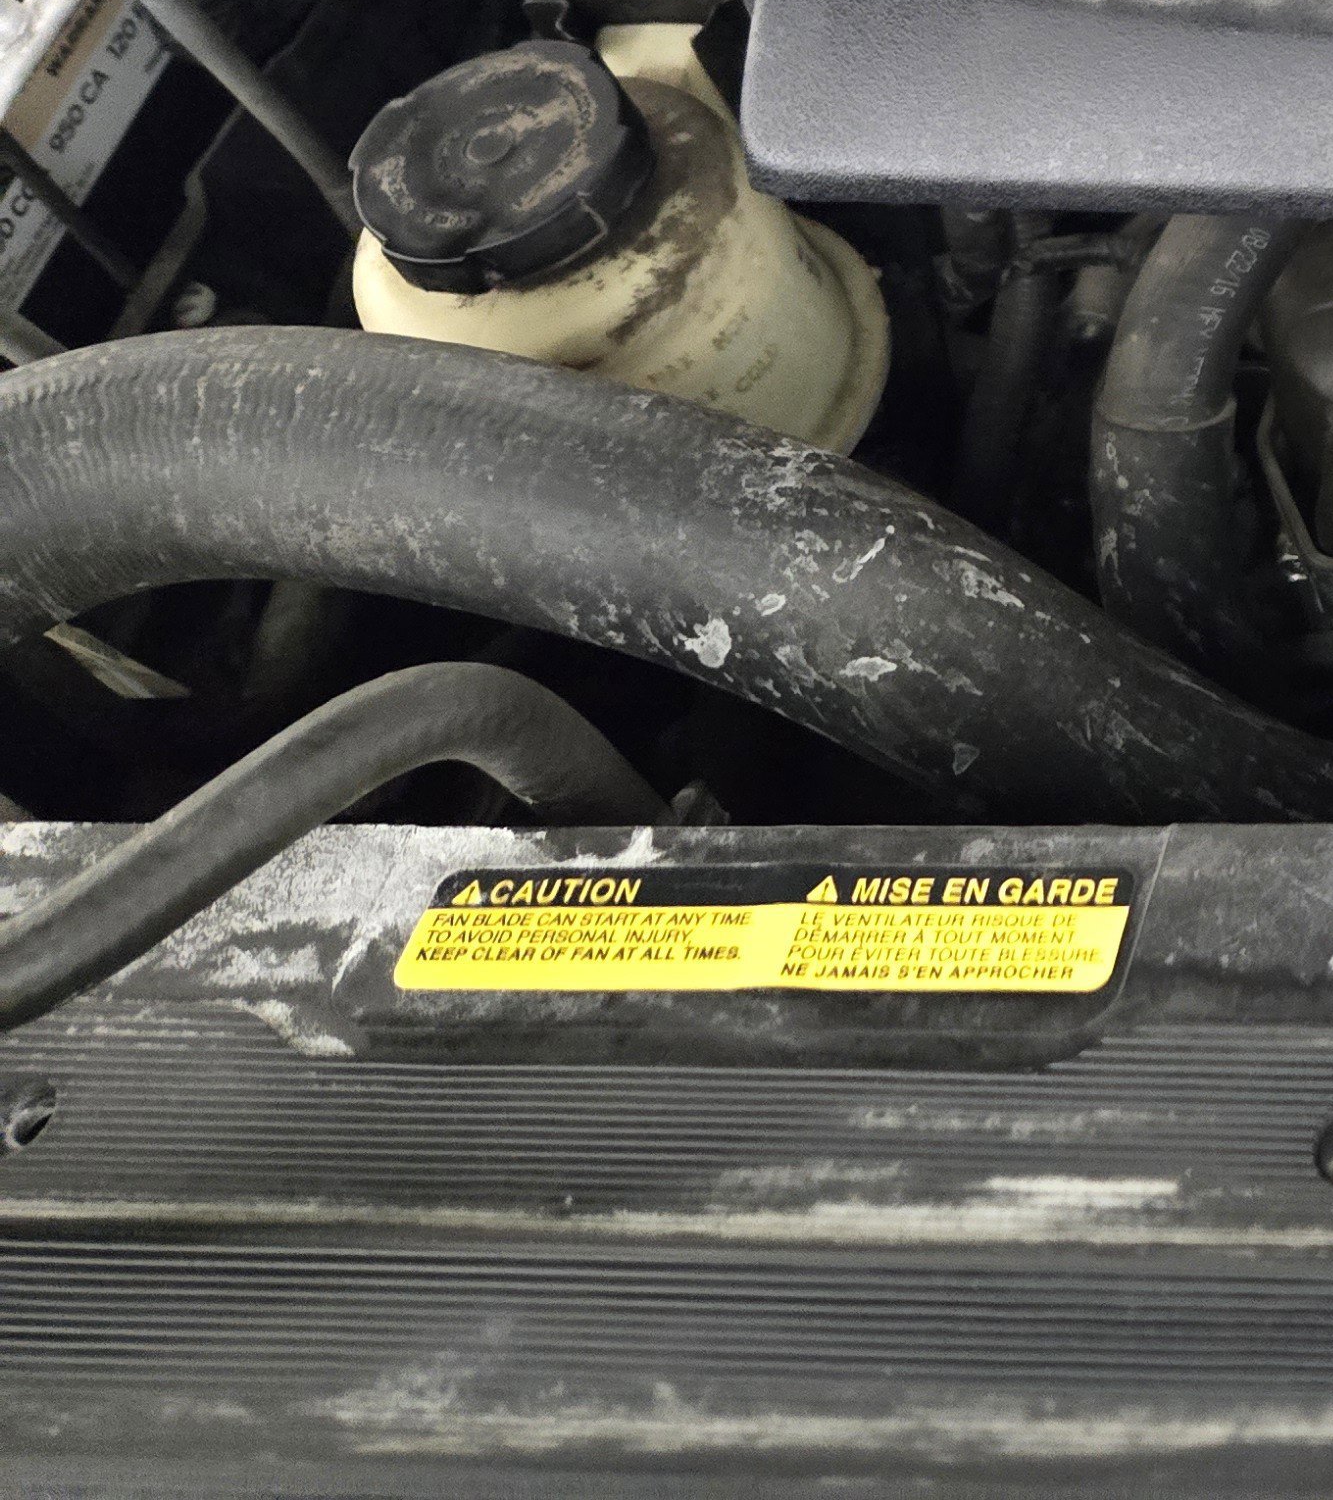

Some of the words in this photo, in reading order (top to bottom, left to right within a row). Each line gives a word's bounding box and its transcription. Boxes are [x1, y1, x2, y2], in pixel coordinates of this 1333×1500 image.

[490, 879, 641, 905] CAUTION
[851, 877, 936, 904] MISE
[942, 878, 990, 904] EN
[998, 877, 1119, 905] GARDE
[432, 913, 471, 927] FAN
[472, 913, 532, 927] BLADE
[537, 912, 577, 927] CAN
[580, 912, 640, 927] START
[641, 912, 665, 926] AT
[666, 912, 707, 926] ANY
[711, 911, 752, 926] TIME
[800, 911, 825, 925] LE
[833, 913, 964, 927] VENTILATEUR
[972, 913, 1045, 927] RISQUE
[1052, 913, 1078, 927] DE
[427, 929, 451, 944] TO
[453, 929, 512, 944] AVOID
[517, 929, 616, 944] PERSONAL
[935, 930, 983, 944] TOUT
[991, 930, 1076, 944] MOMENT
[416, 947, 467, 961] KEEP
[471, 947, 536, 961] CLEAR
[540, 947, 567, 961] OF
[570, 947, 610, 961] FAN
[612, 946, 638, 961] AT
[640, 946, 675, 961] ALL
[684, 946, 741, 961] TIMES.
[788, 945, 844, 960] POUR
[930, 947, 990, 961] TOUTE
[781, 962, 809, 976] NE
[815, 964, 890, 978] JAMAIS
[898, 965, 942, 978] S'EN
[949, 965, 1073, 979] APPROCHER
